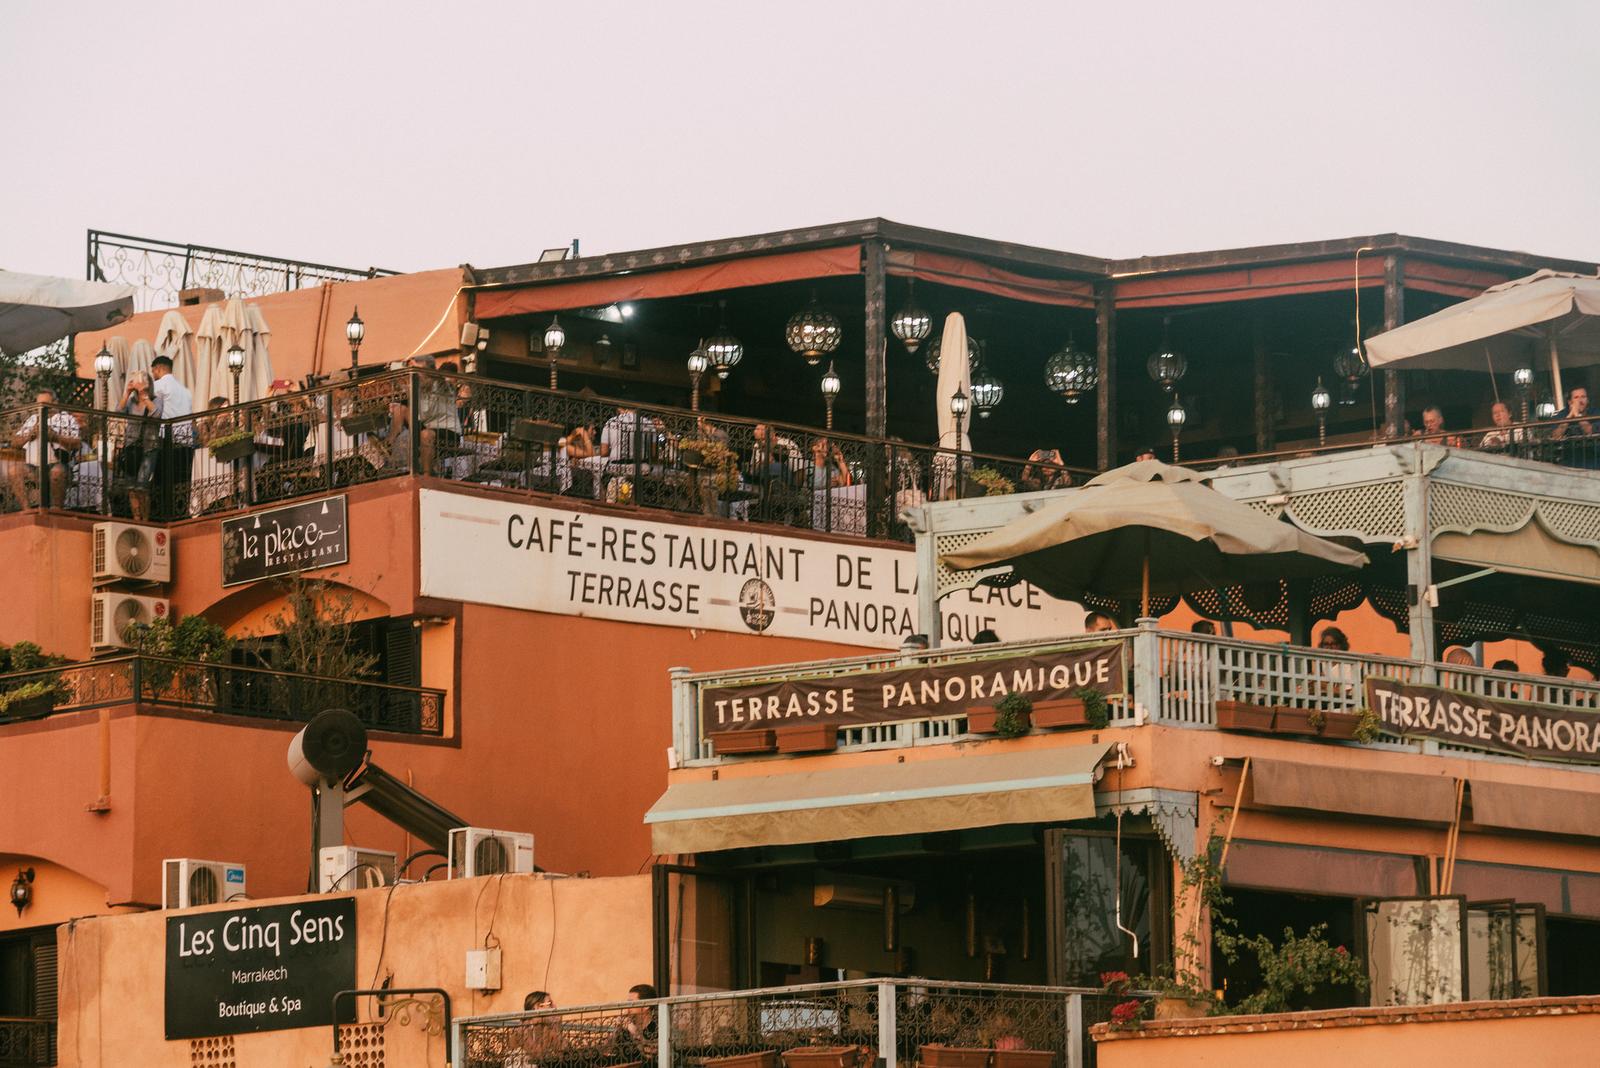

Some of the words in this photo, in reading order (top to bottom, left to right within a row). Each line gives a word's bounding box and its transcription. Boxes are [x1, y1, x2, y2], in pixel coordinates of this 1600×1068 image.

[238, 527, 259, 559] la
[264, 520, 341, 567] place
[507, 514, 805, 582] CAFÉ-RESTAURANT
[836, 554, 873, 590] DE
[894, 559, 919, 595] L
[946, 579, 1041, 610] LACE
[567, 570, 700, 614] TERRASSE
[810, 597, 996, 643] PANORAIQU
[714, 688, 855, 724] TERRASSE
[882, 658, 1110, 708] PANORAMIQUE
[1375, 688, 1492, 740] TERRASSE
[178, 921, 215, 957] Les
[222, 915, 281, 956] Cinq
[289, 909, 345, 946] Sens
[231, 965, 288, 985] Marrakech
[218, 999, 266, 1018] Boutique
[268, 997, 279, 1013] &
[281, 996, 302, 1016] Spa
